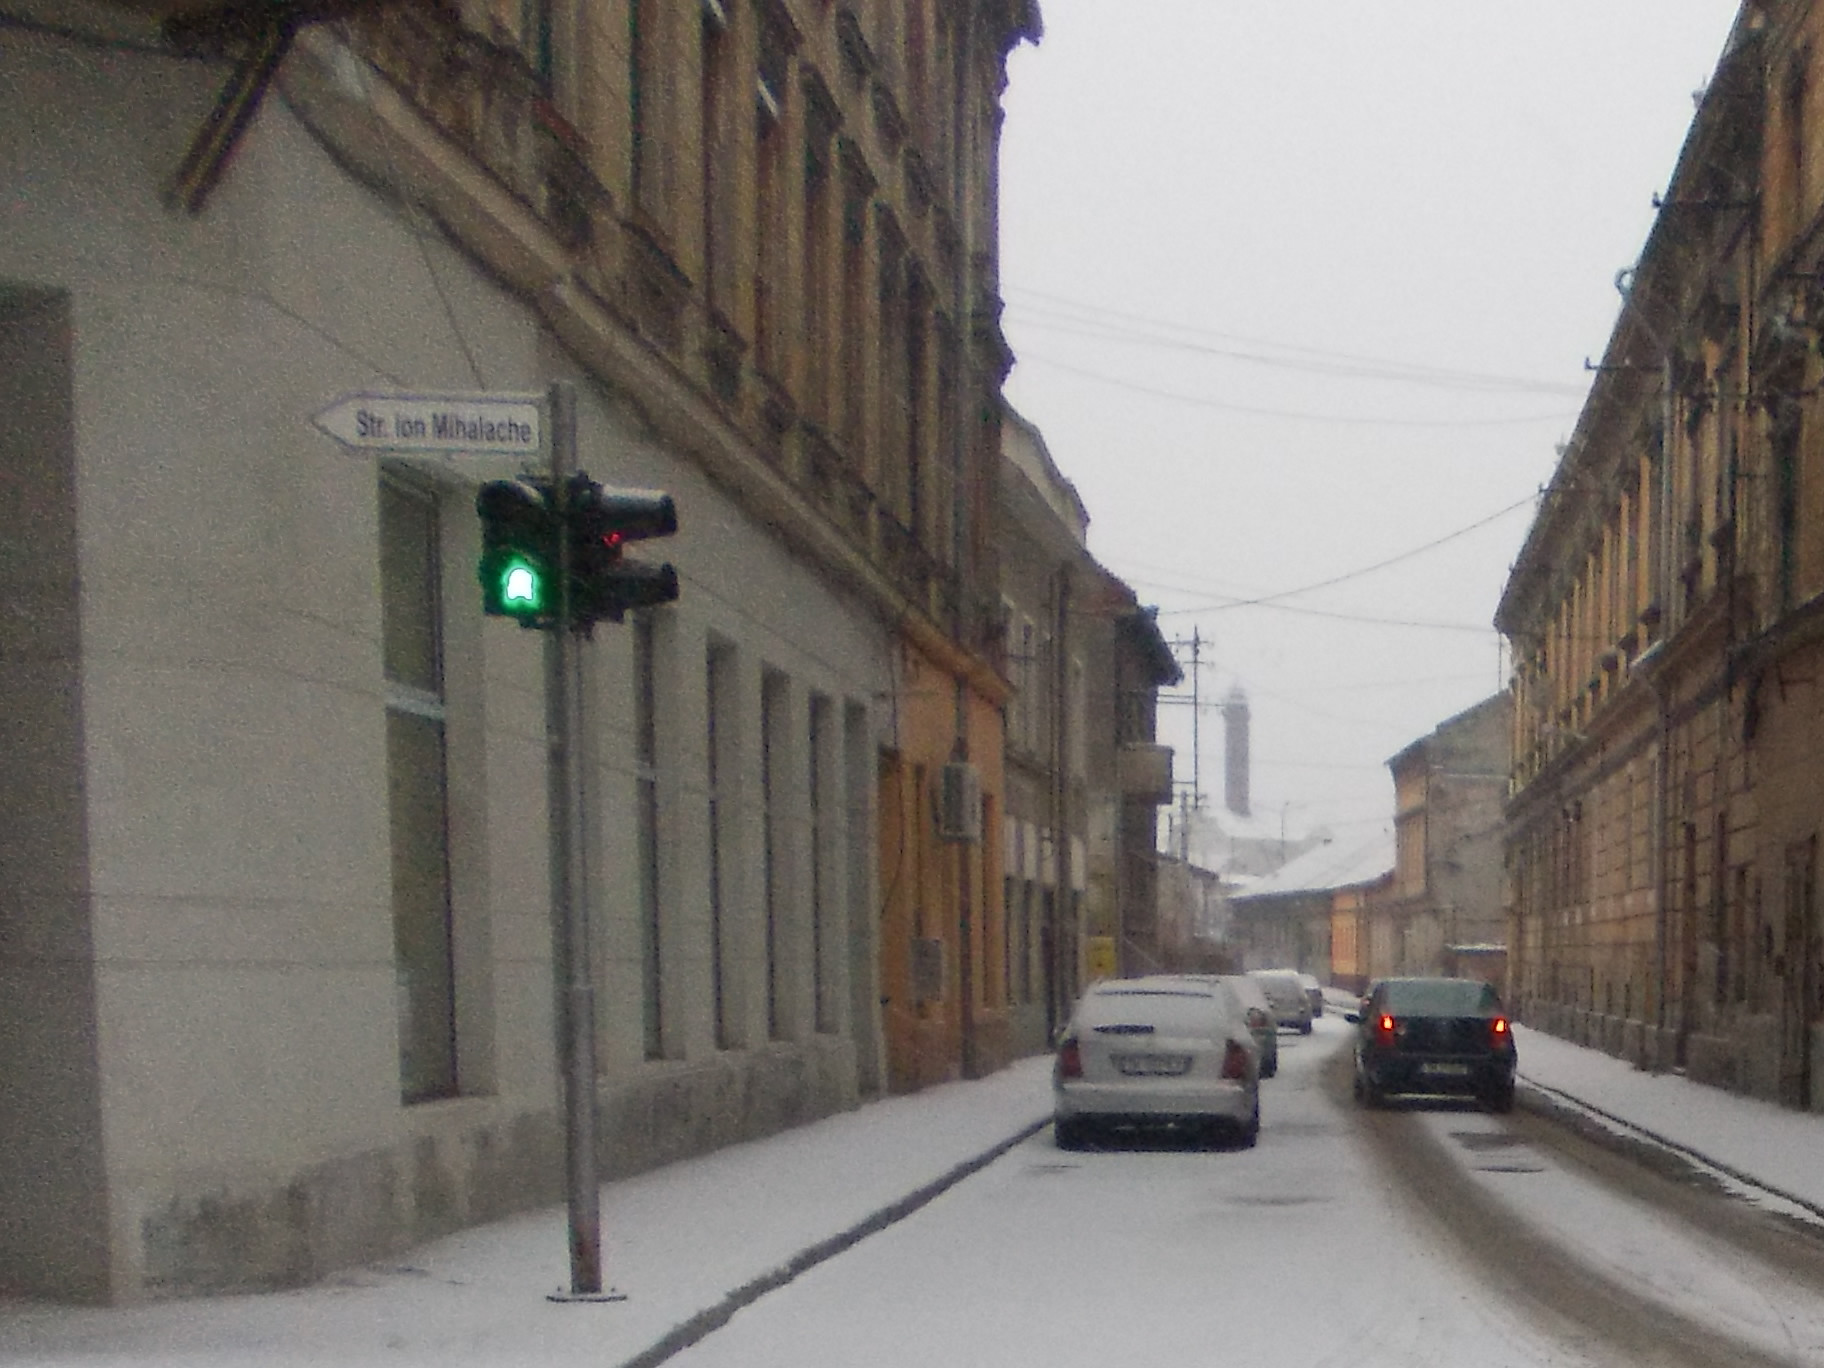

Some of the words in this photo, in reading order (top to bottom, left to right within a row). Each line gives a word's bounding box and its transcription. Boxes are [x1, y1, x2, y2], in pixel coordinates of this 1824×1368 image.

[357, 409, 388, 437] Str.
[395, 413, 426, 438] Ion
[432, 413, 531, 443] Mihalache
